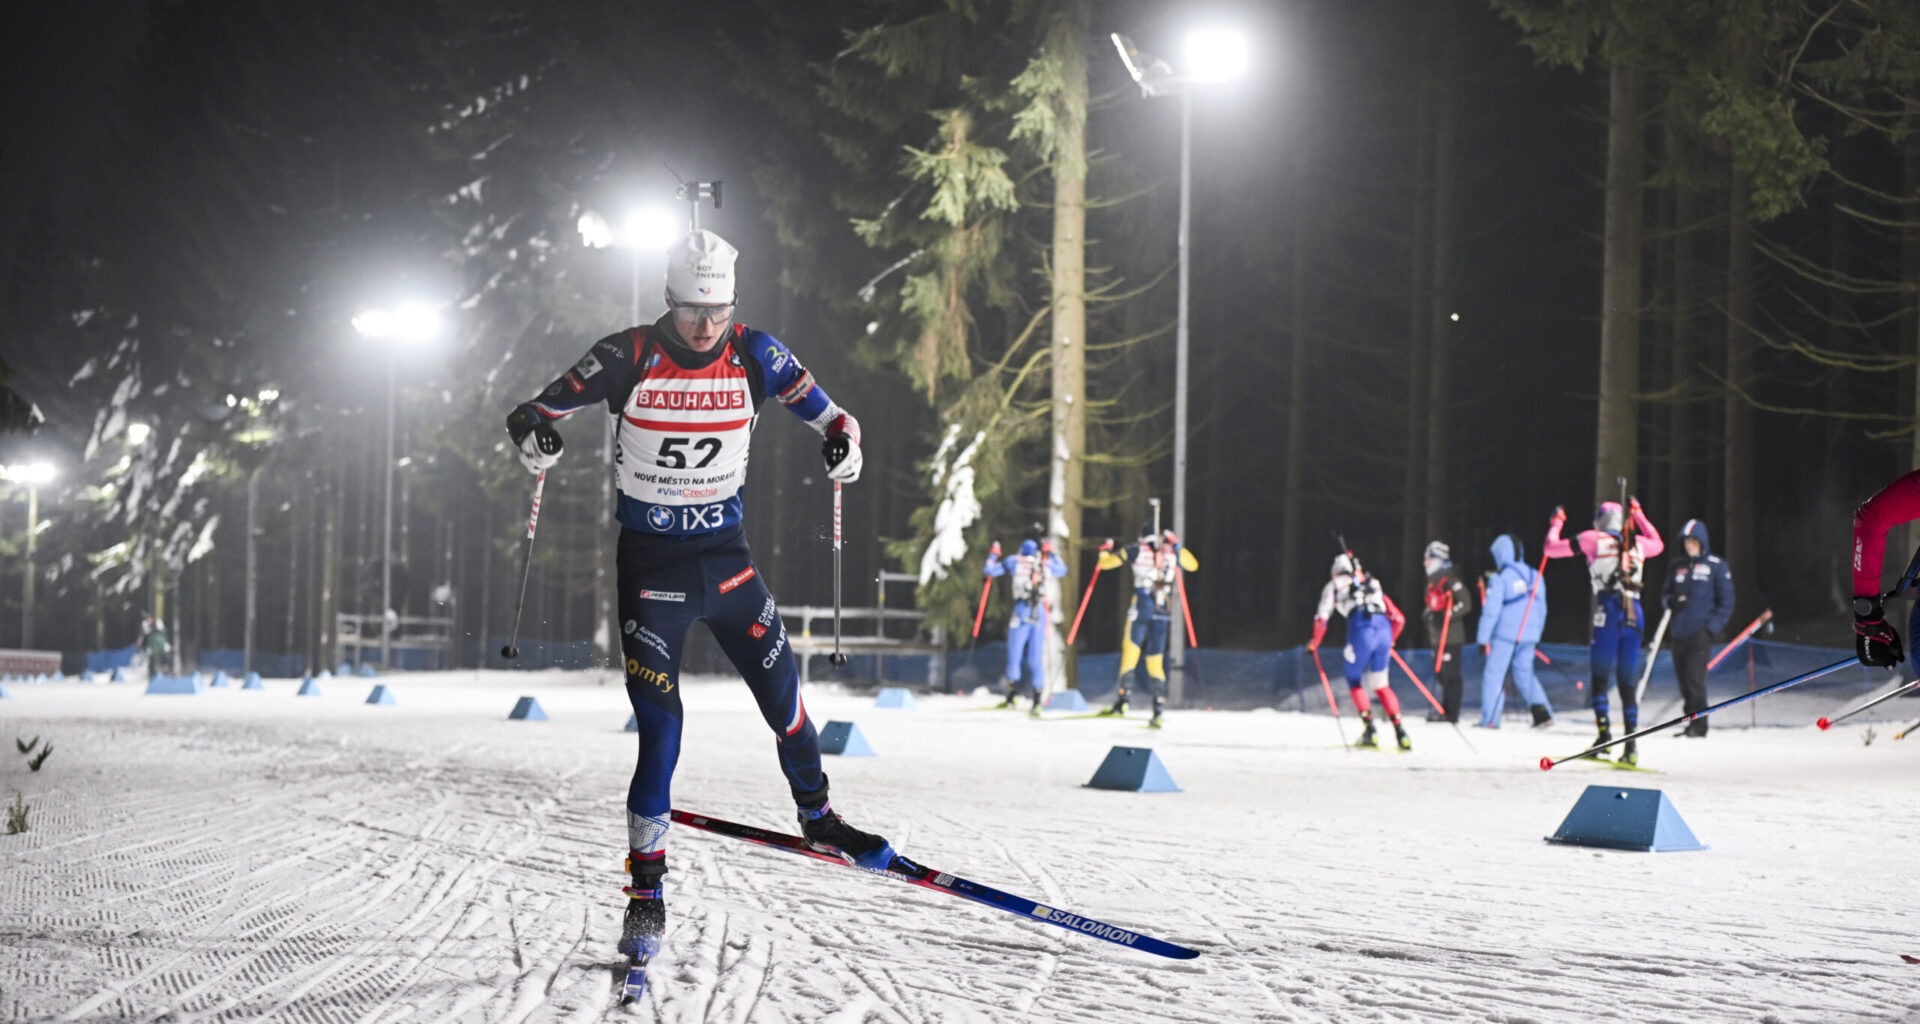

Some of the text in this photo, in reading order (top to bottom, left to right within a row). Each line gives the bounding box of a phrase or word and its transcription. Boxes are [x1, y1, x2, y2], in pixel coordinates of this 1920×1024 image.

[638, 390, 744, 410] BAUHAUS
[656, 437, 723, 469] 52
[633, 471, 657, 484] NOVÉ
[691, 477, 705, 485] NA
[657, 486, 718, 497] #VisitCzechia
[682, 504, 725, 530] iX3
[625, 656, 675, 693] omfy
[1049, 910, 1139, 945] SALOMON
